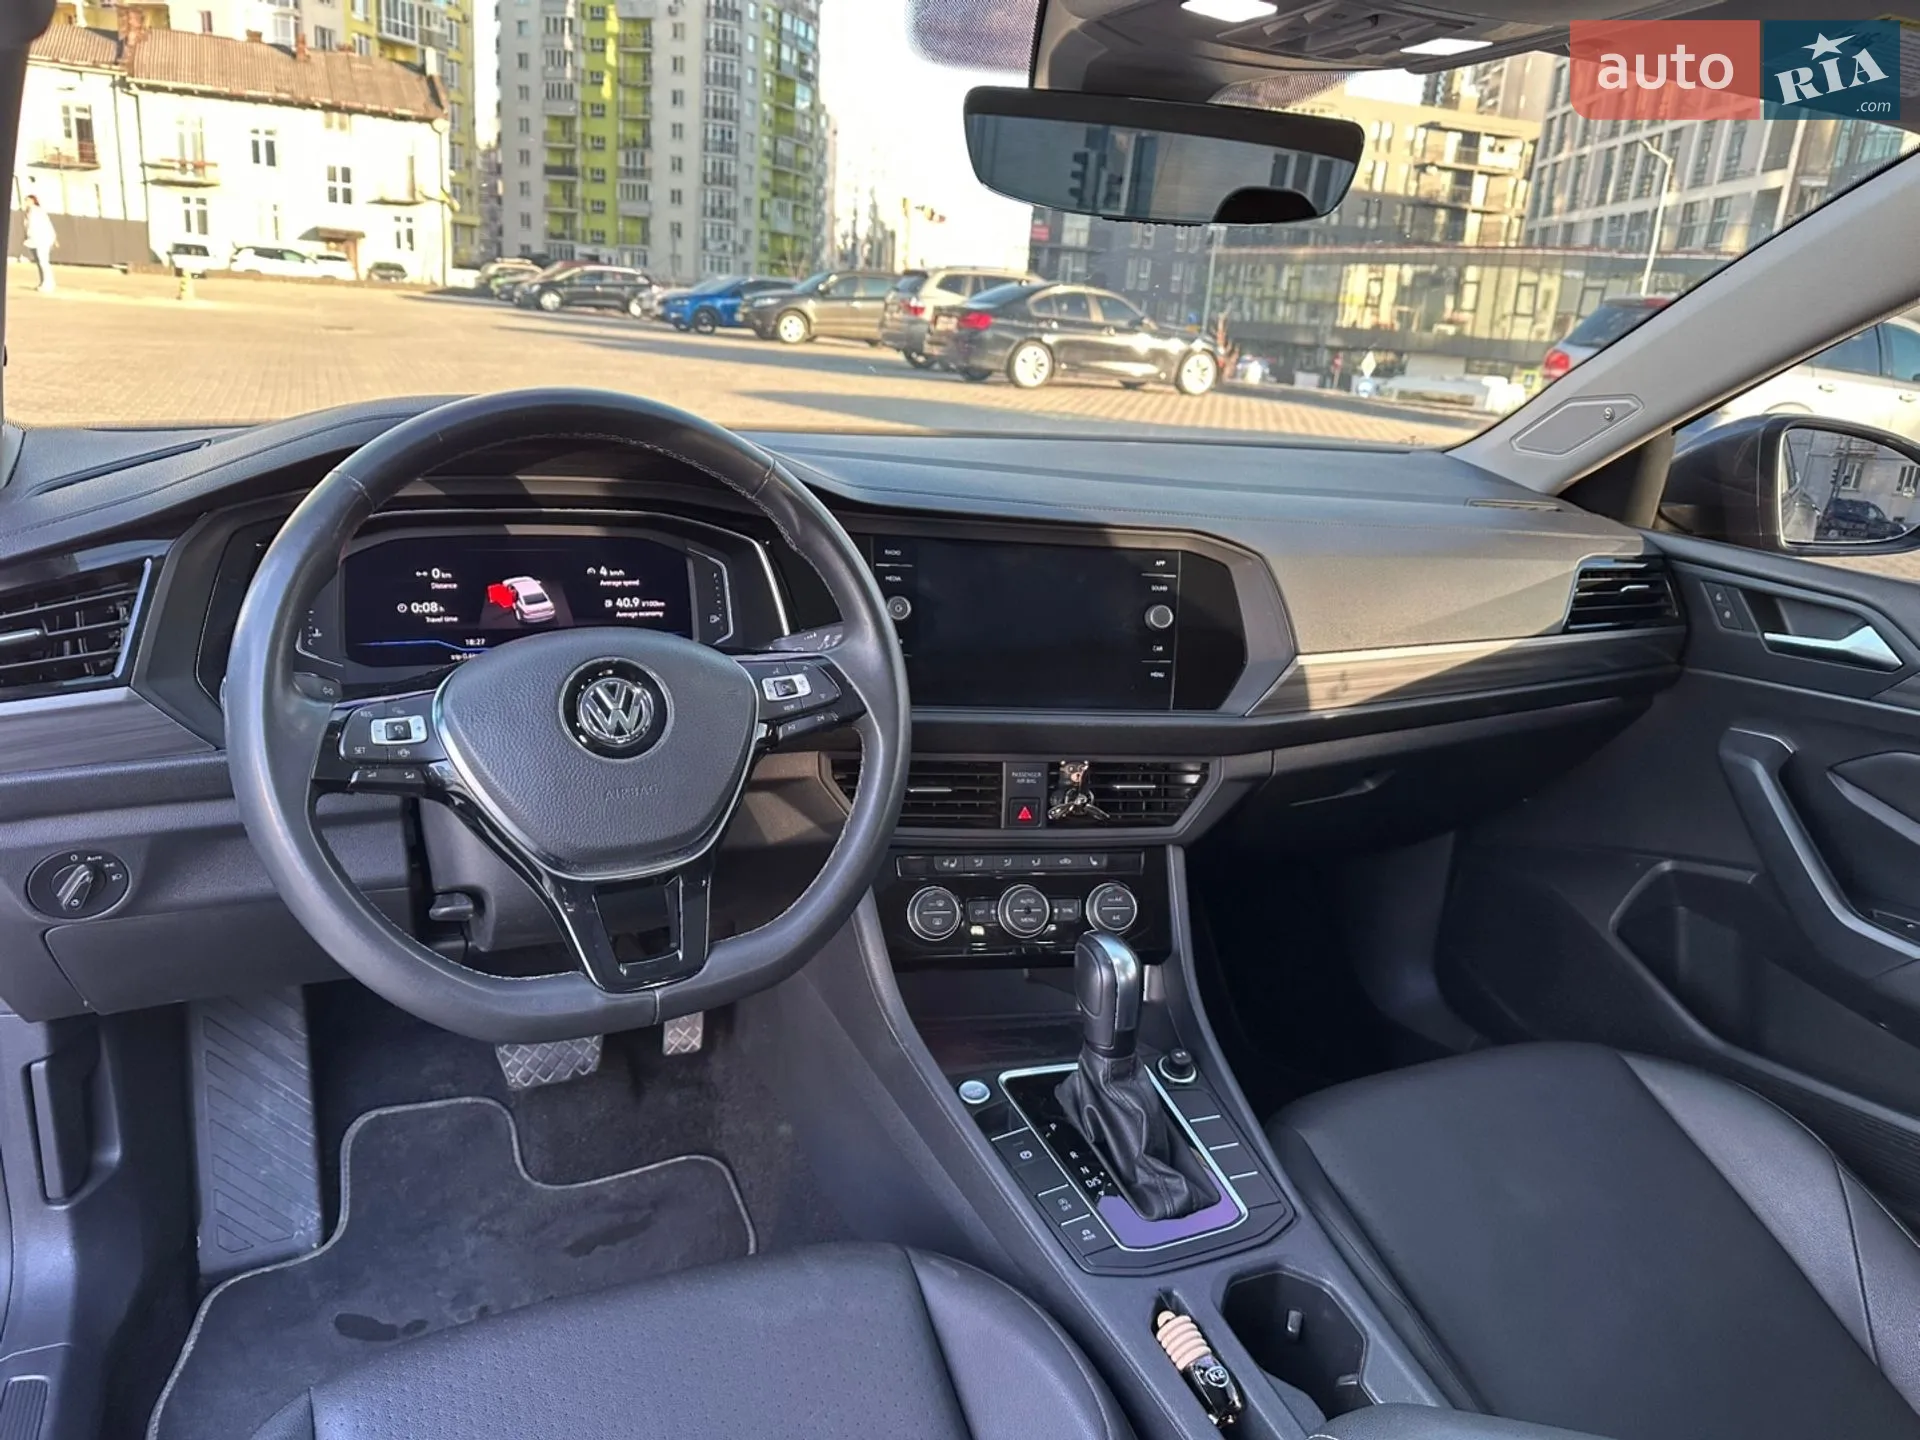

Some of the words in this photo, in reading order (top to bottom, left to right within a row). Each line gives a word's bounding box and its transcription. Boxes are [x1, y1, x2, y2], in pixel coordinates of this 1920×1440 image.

[431, 567, 440, 579] 0
[599, 565, 608, 577] 4
[410, 601, 439, 614] 0:08
[615, 596, 640, 608] 40.9
[1069, 1150, 1079, 1160] R
